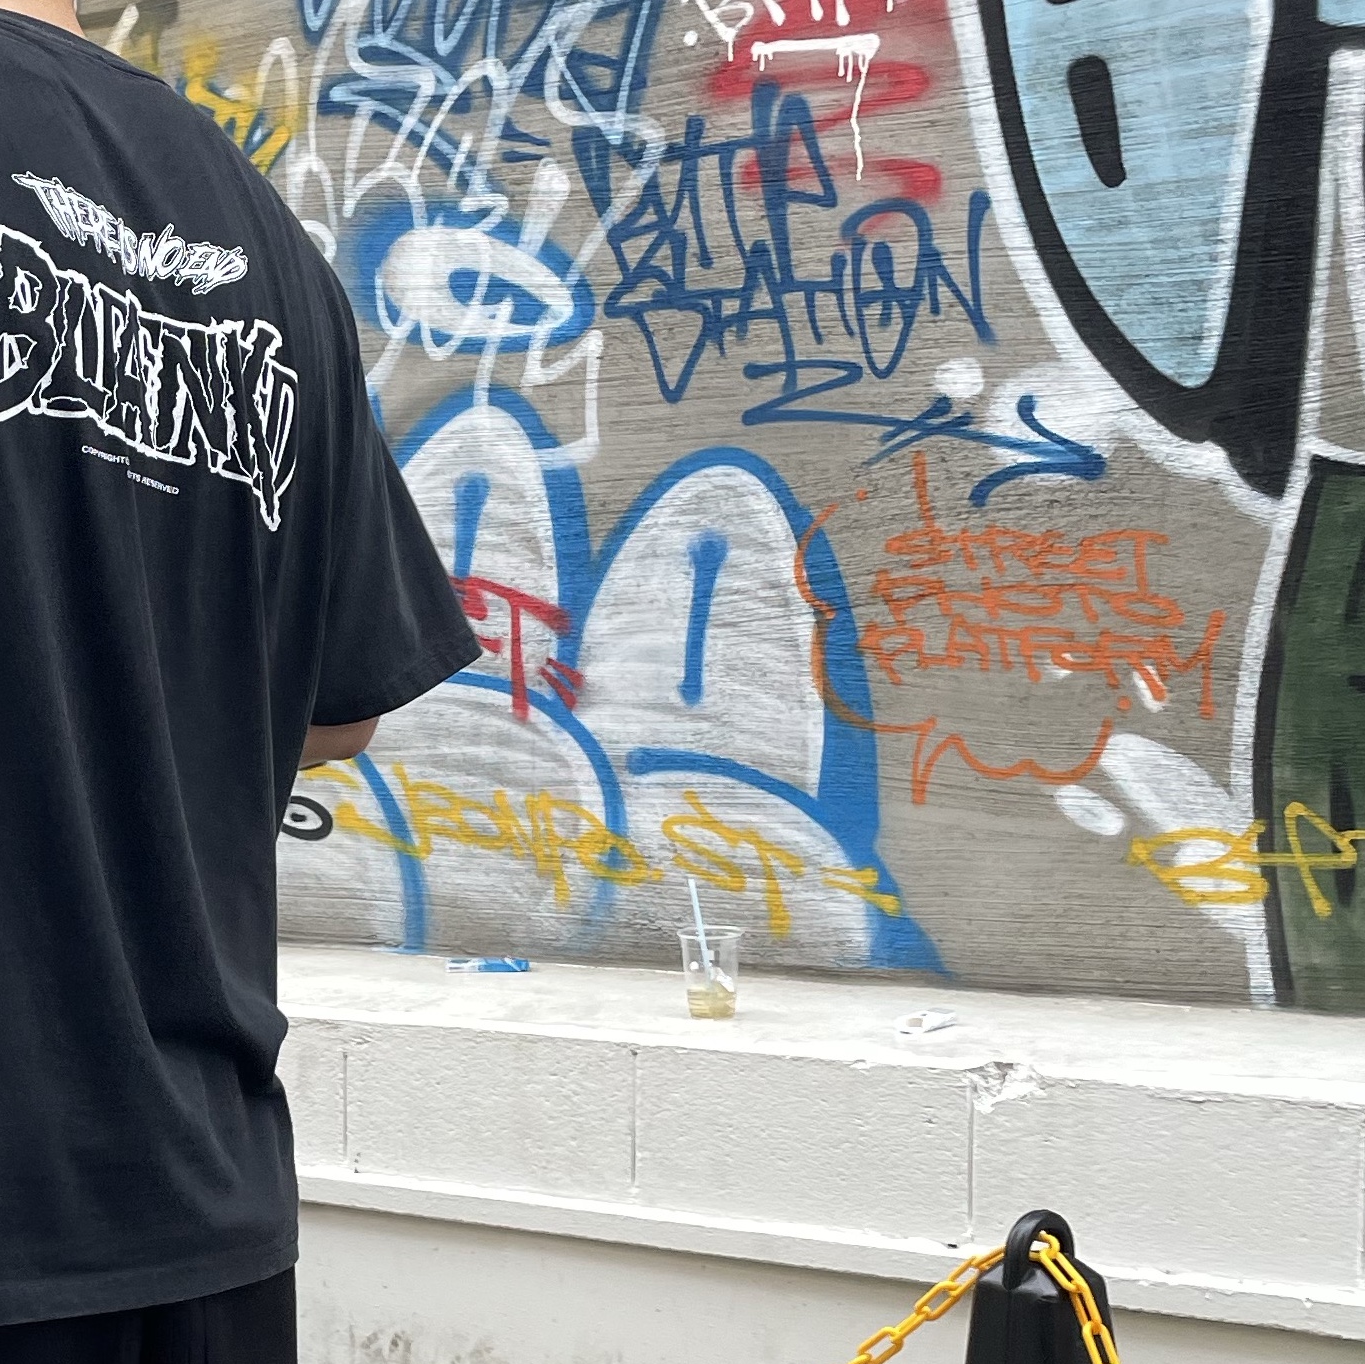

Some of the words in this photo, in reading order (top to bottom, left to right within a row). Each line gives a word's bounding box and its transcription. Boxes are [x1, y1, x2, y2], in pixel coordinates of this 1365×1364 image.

[137, 222, 187, 282] NO
[176, 242, 249, 295] END
[885, 490, 1169, 602] STREET
[872, 569, 1184, 627] PHOTO
[858, 609, 1226, 720] PLATFORM
